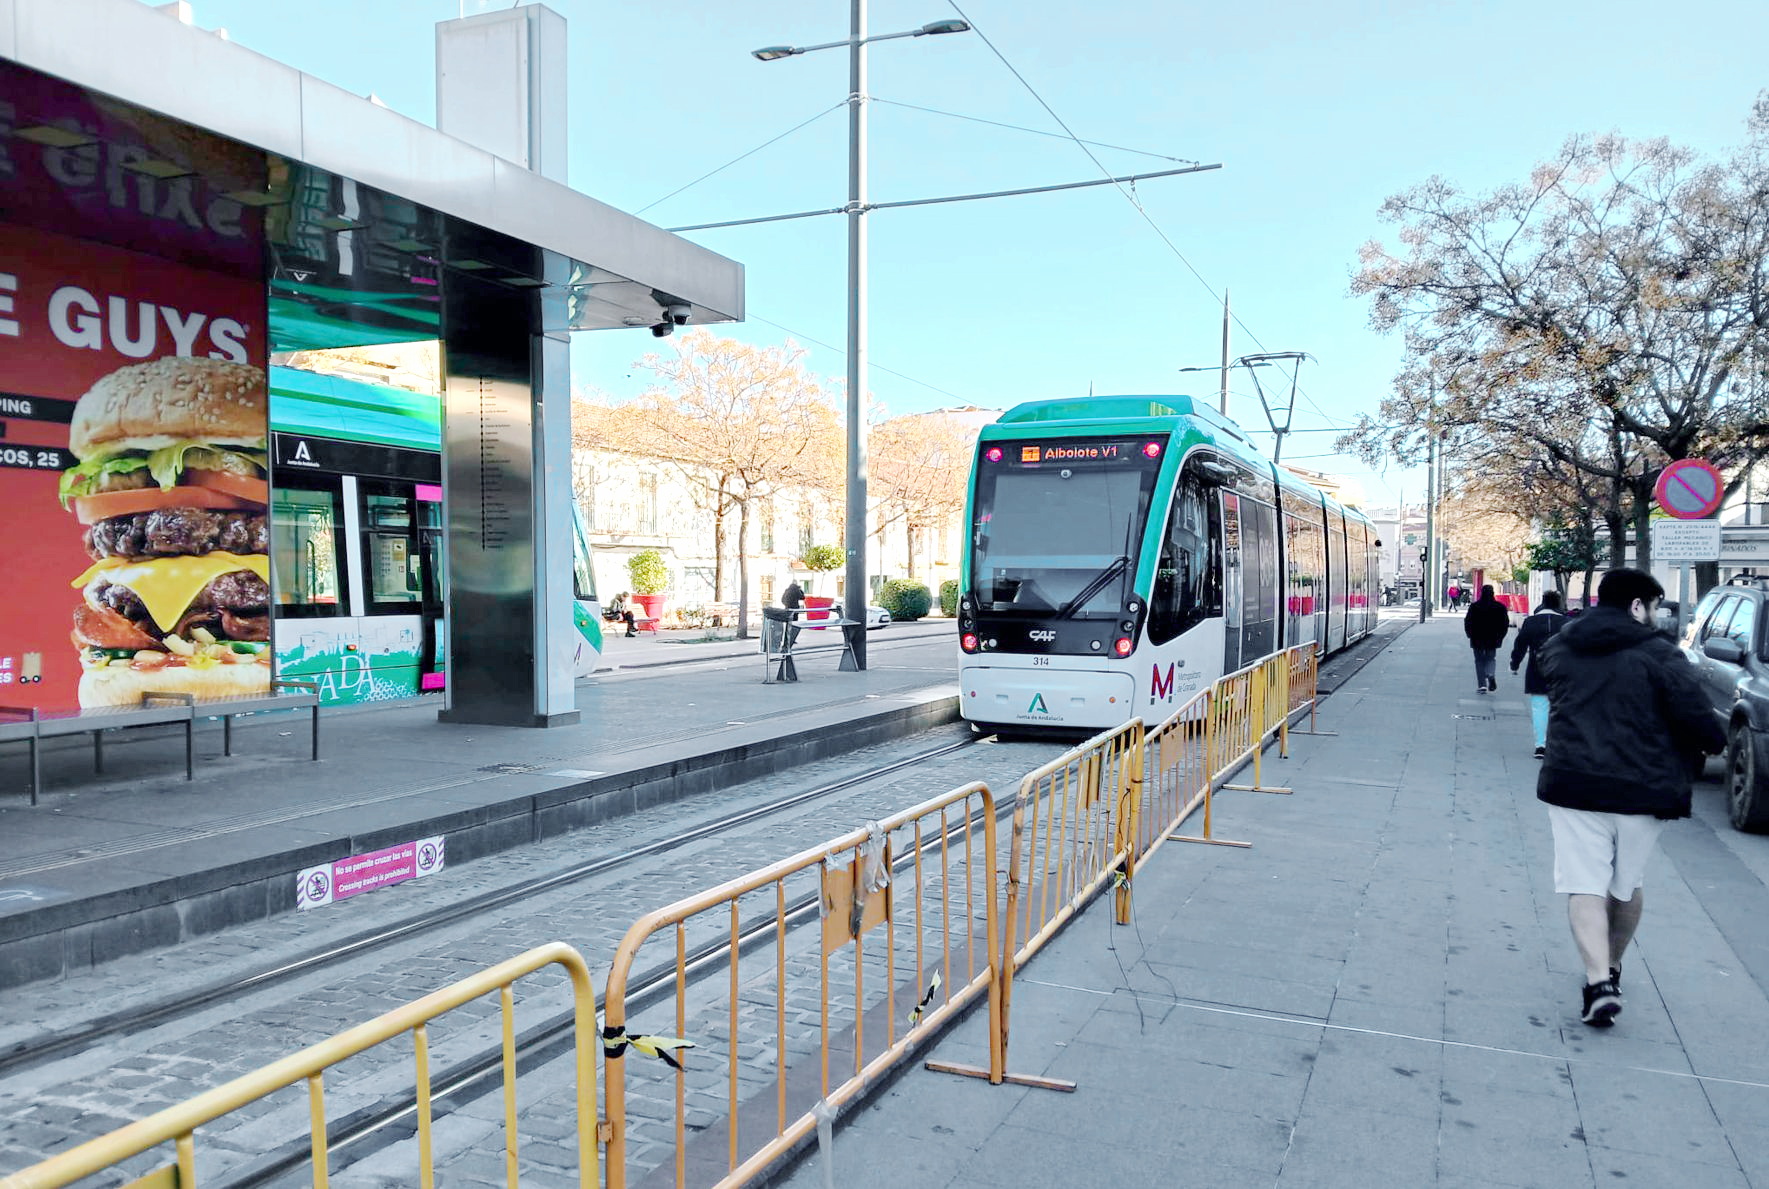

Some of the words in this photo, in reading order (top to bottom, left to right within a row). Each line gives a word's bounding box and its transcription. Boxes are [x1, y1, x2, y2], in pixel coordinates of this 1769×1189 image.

[48, 286, 248, 365] GUYS
[37, 452, 59, 467] 25
[1044, 448, 1099, 460] Albolote
[1102, 446, 1118, 457] V1
[1029, 630, 1056, 642] CAF
[1033, 657, 1049, 666] 314
[335, 866, 344, 875] No
[345, 865, 352, 873] se
[353, 859, 374, 873] permite
[374, 855, 392, 865] cruzar
[392, 852, 401, 861] las
[338, 881, 363, 893] Crossing
[363, 875, 378, 886] tracks
[378, 873, 384, 881] is
[384, 865, 410, 881] prohibited
